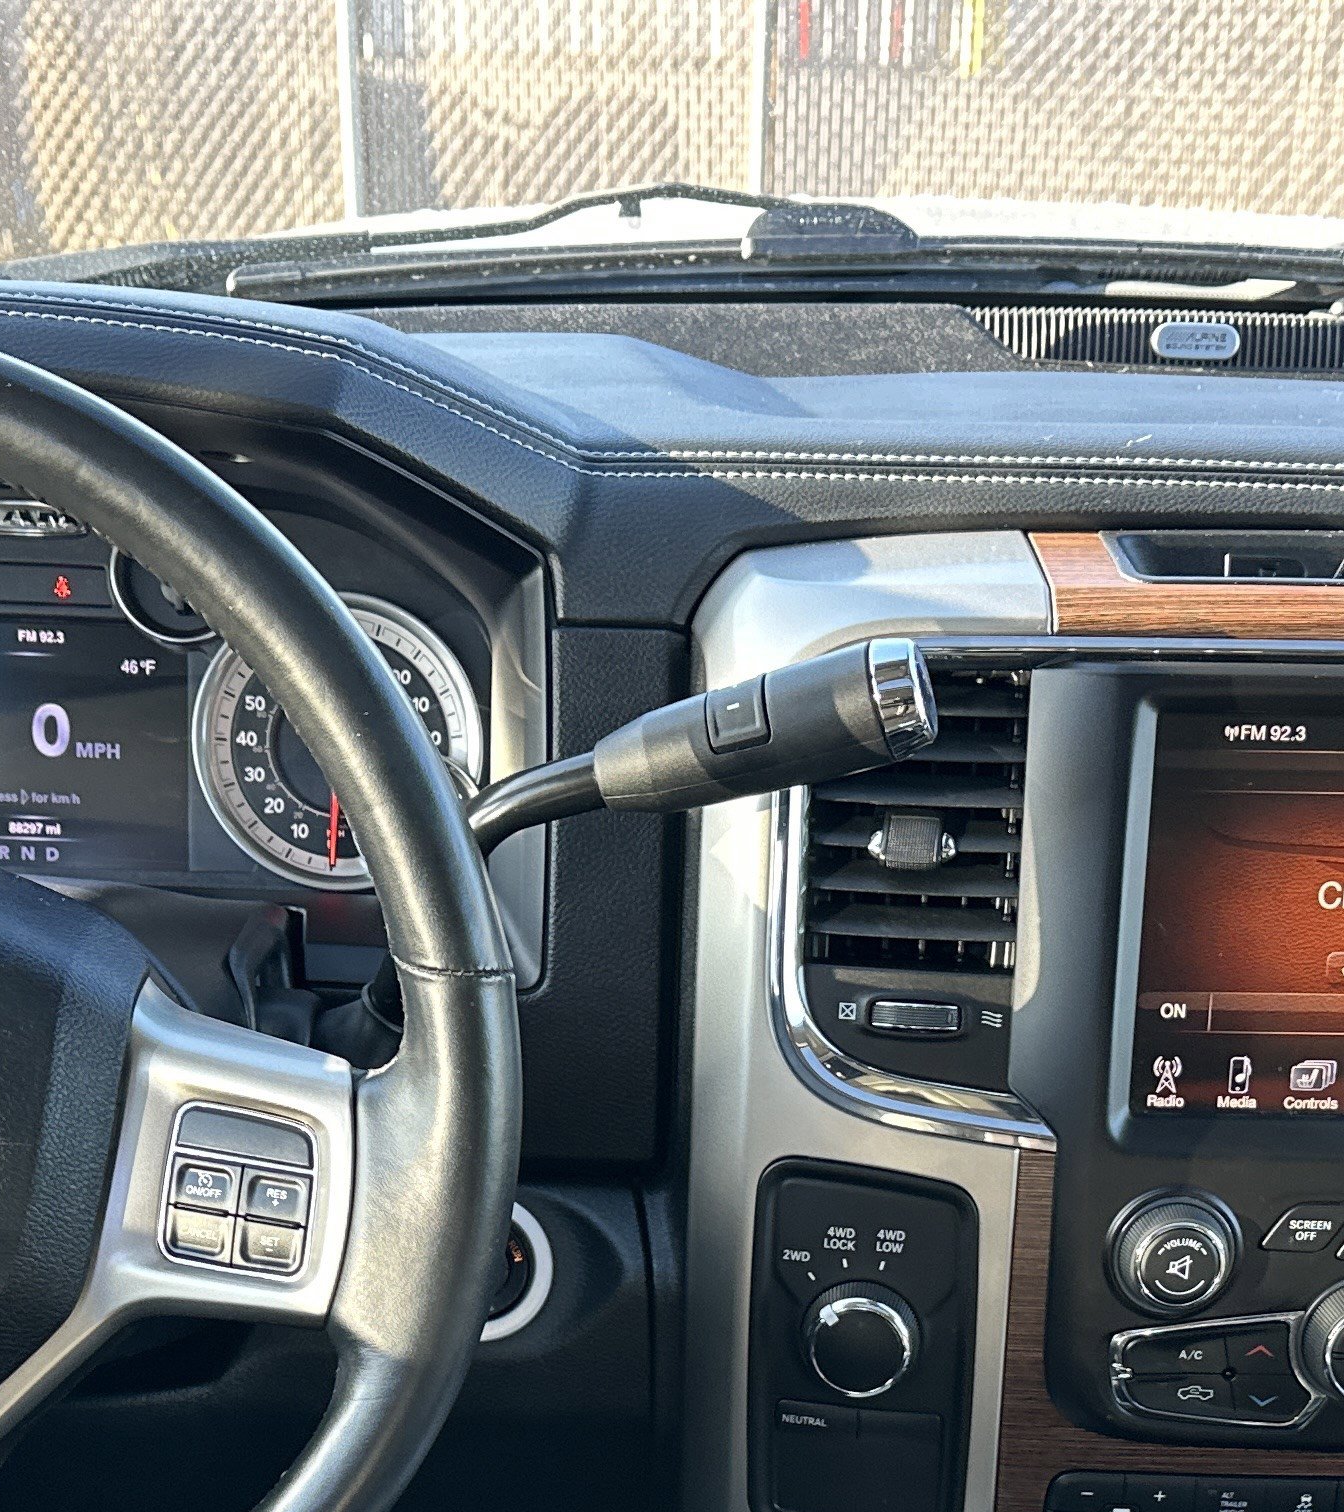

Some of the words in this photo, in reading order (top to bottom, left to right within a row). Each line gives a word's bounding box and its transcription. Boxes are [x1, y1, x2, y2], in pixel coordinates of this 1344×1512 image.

[17, 629, 37, 643] FM
[38, 629, 65, 644] 92.3
[120, 658, 156, 676] 46°F
[244, 695, 266, 712] 50
[31, 702, 71, 758] 0
[75, 741, 121, 760] MPH
[235, 729, 258, 747] 40
[1240, 725, 1267, 742] FM
[1269, 725, 1307, 743] 92.3
[244, 766, 266, 783] 30
[263, 797, 285, 815] 20
[290, 822, 309, 840] 10
[20, 845, 36, 861] N
[45, 845, 60, 862] D
[1159, 1002, 1187, 1019] ON
[1146, 1094, 1185, 1109] Radio
[1216, 1095, 1257, 1110] Media
[1283, 1096, 1339, 1111] Controls
[266, 1187, 288, 1200] RES
[826, 1226, 856, 1239] 4WD
[1288, 1219, 1332, 1231] SCREEN
[259, 1235, 281, 1247] SET
[876, 1229, 906, 1242] 4WD
[1295, 1231, 1317, 1242] OFF
[823, 1238, 857, 1252] LOCK
[875, 1240, 905, 1254] LOW
[1163, 1237, 1203, 1251] VOLUME
[782, 1250, 811, 1263] 2WD
[1178, 1349, 1204, 1361] A/C
[781, 1413, 828, 1428] NEUTRAL
